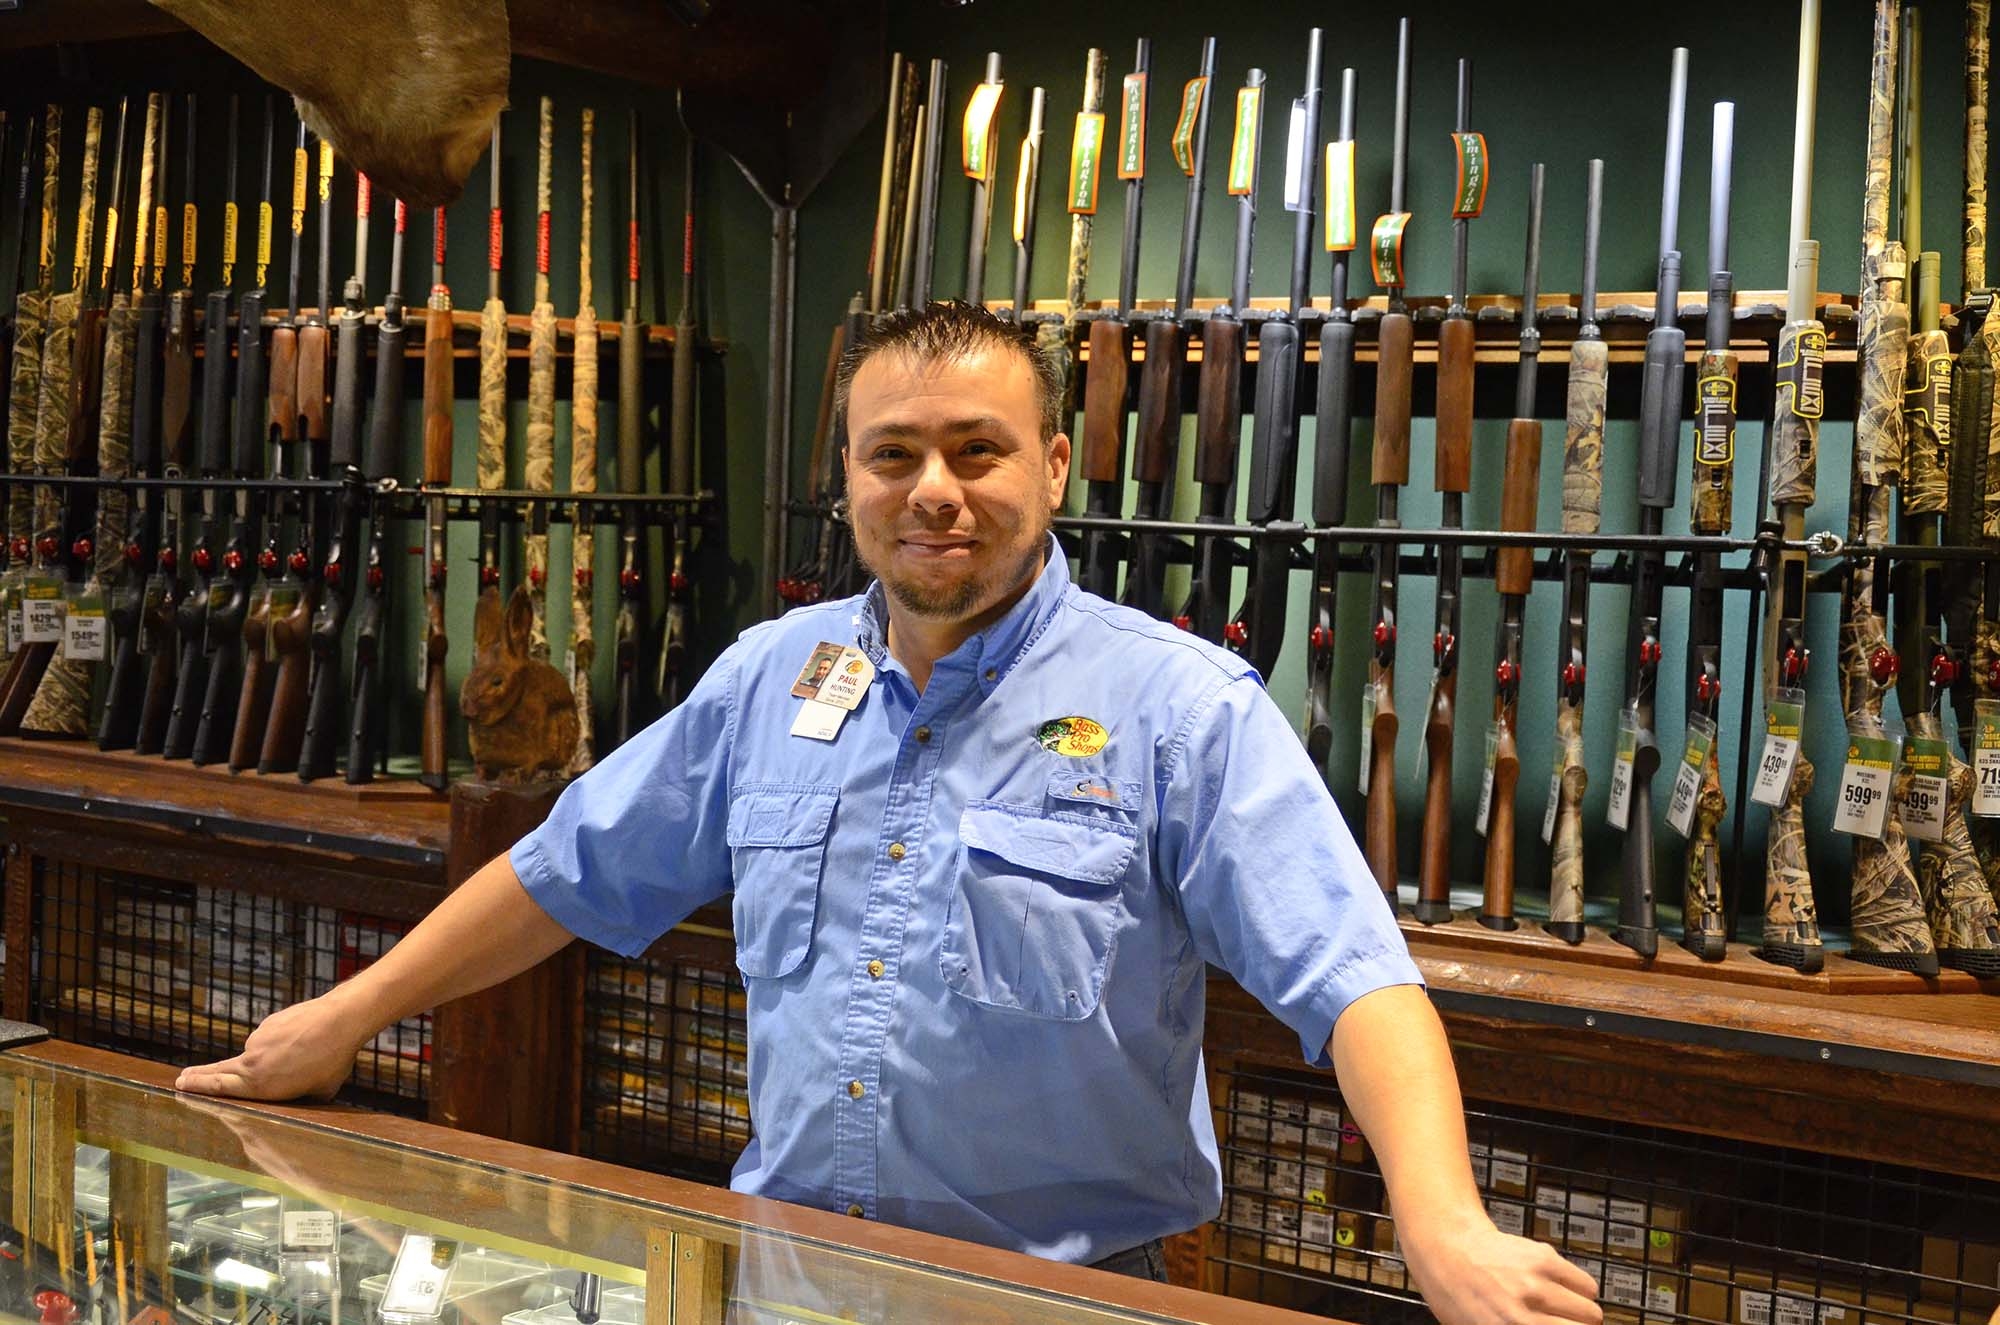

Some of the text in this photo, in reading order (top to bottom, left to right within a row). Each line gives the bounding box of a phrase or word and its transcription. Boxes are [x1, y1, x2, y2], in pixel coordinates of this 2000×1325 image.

[838, 674, 858, 686] PAUL
[830, 684, 856, 696] HUNTING
[1072, 719, 1100, 735] Bass
[1071, 731, 1091, 743] Pro
[1067, 740, 1100, 754] Shops
